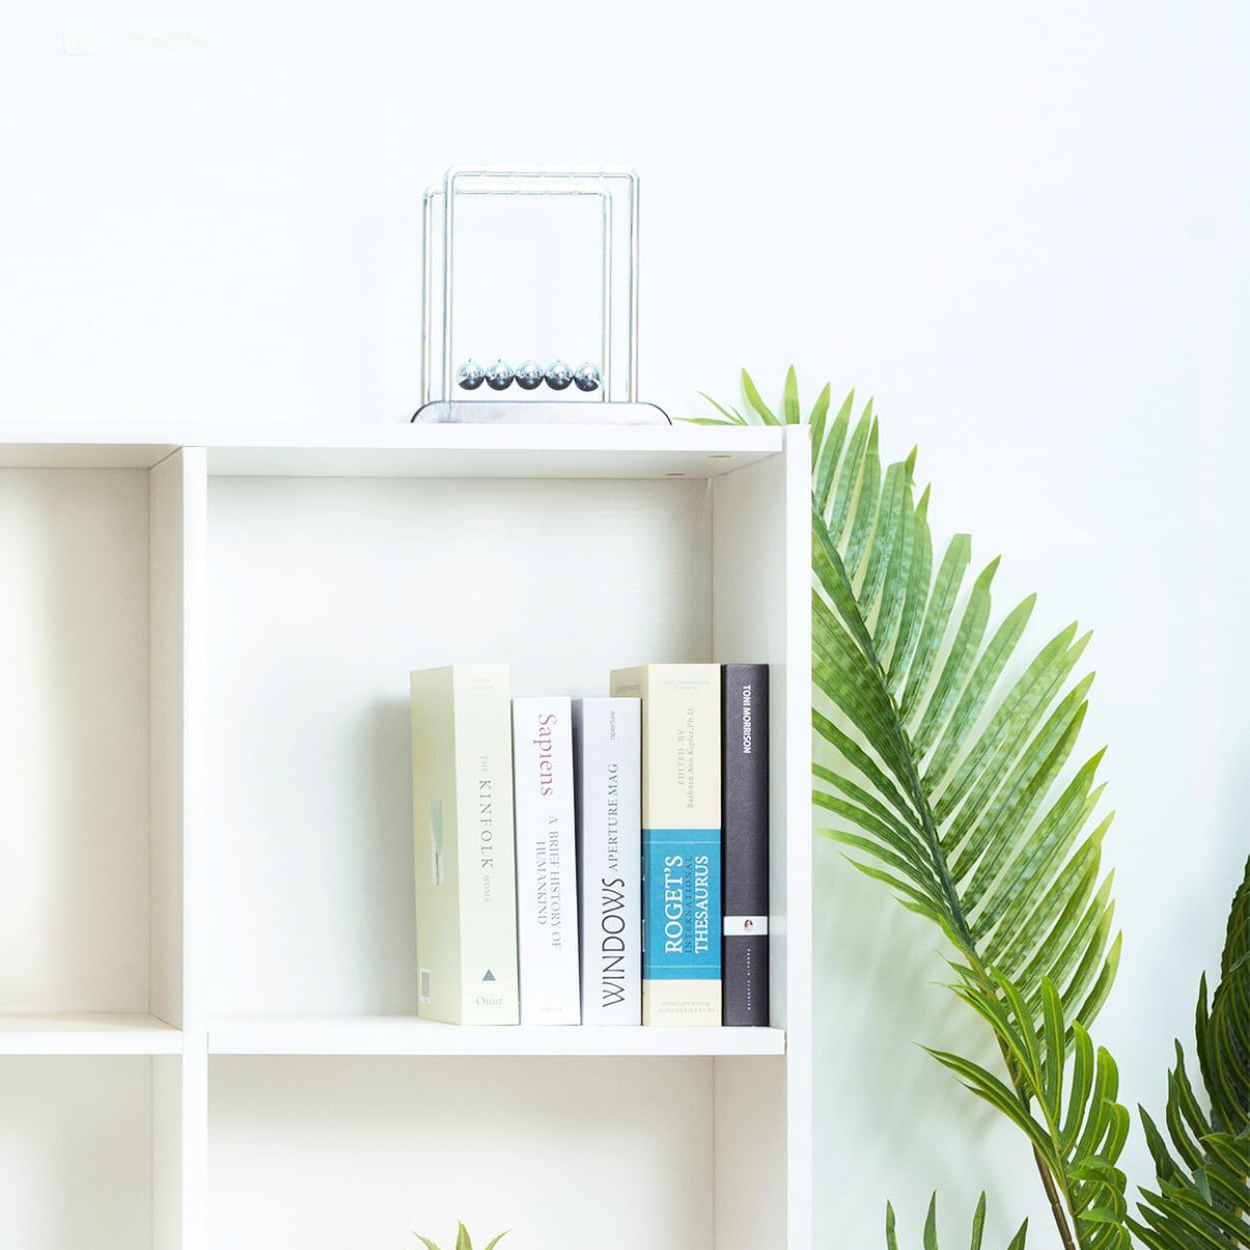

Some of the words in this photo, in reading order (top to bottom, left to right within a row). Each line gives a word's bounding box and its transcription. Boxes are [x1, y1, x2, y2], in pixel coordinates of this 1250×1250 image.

[742, 685, 752, 706] TONI
[533, 713, 557, 796] Sapiens
[678, 729, 685, 745] BY
[742, 707, 752, 753] MORRISON
[607, 764, 618, 795] MAG
[479, 779, 493, 870] KINFOLK
[548, 816, 559, 824] A
[607, 799, 618, 871] APERTURE
[549, 831, 560, 869] BRIEF
[536, 841, 548, 924] HUMANKIND
[549, 871, 561, 928] HISTORY
[665, 856, 682, 953] ROGET'S
[695, 856, 708, 953] THESAURUS
[551, 932, 561, 951] OF
[602, 878, 624, 1007] WINDOWS
